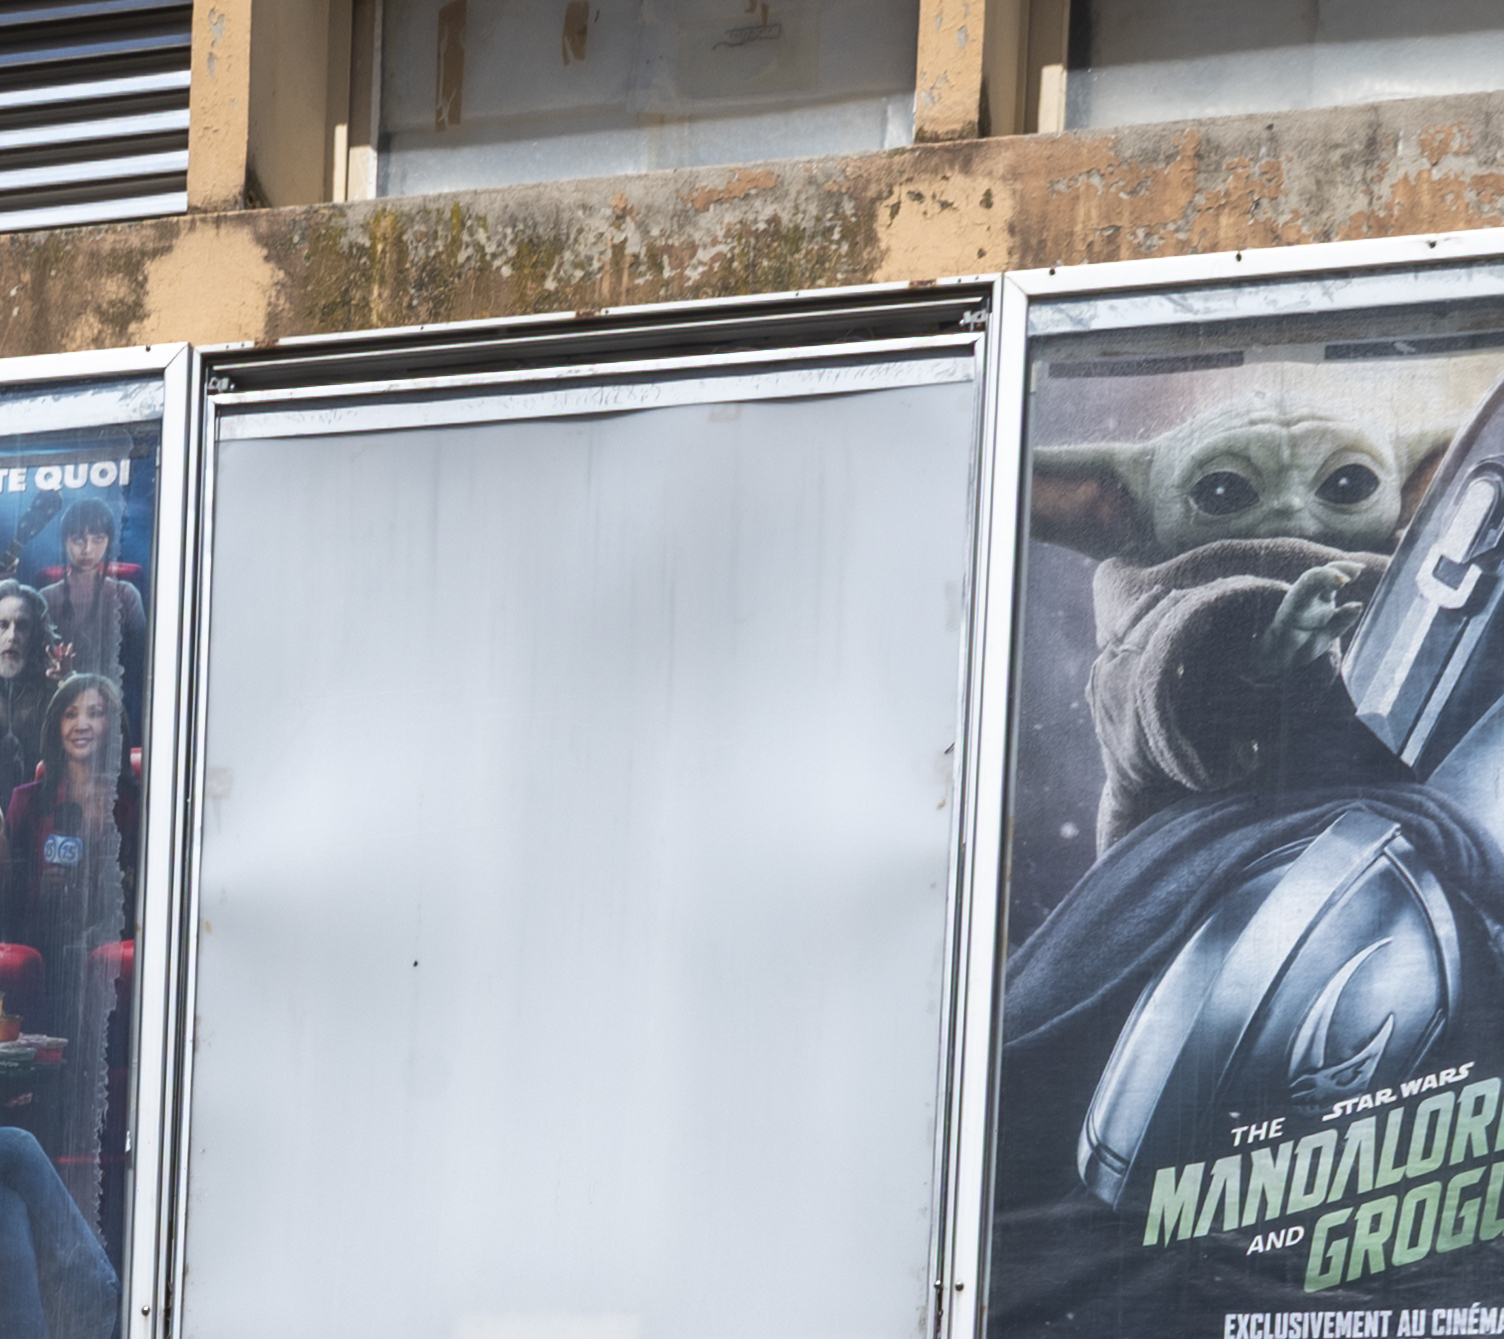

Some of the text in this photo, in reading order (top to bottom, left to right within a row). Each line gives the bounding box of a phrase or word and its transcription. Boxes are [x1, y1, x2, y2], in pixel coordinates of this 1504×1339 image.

[35, 459, 131, 492] QUOI
[1323, 1061, 1475, 1121] STAR WARS
[1231, 1116, 1285, 1147] THE
[1246, 1225, 1305, 1256] AND
[1397, 1310, 1427, 1337] AU
